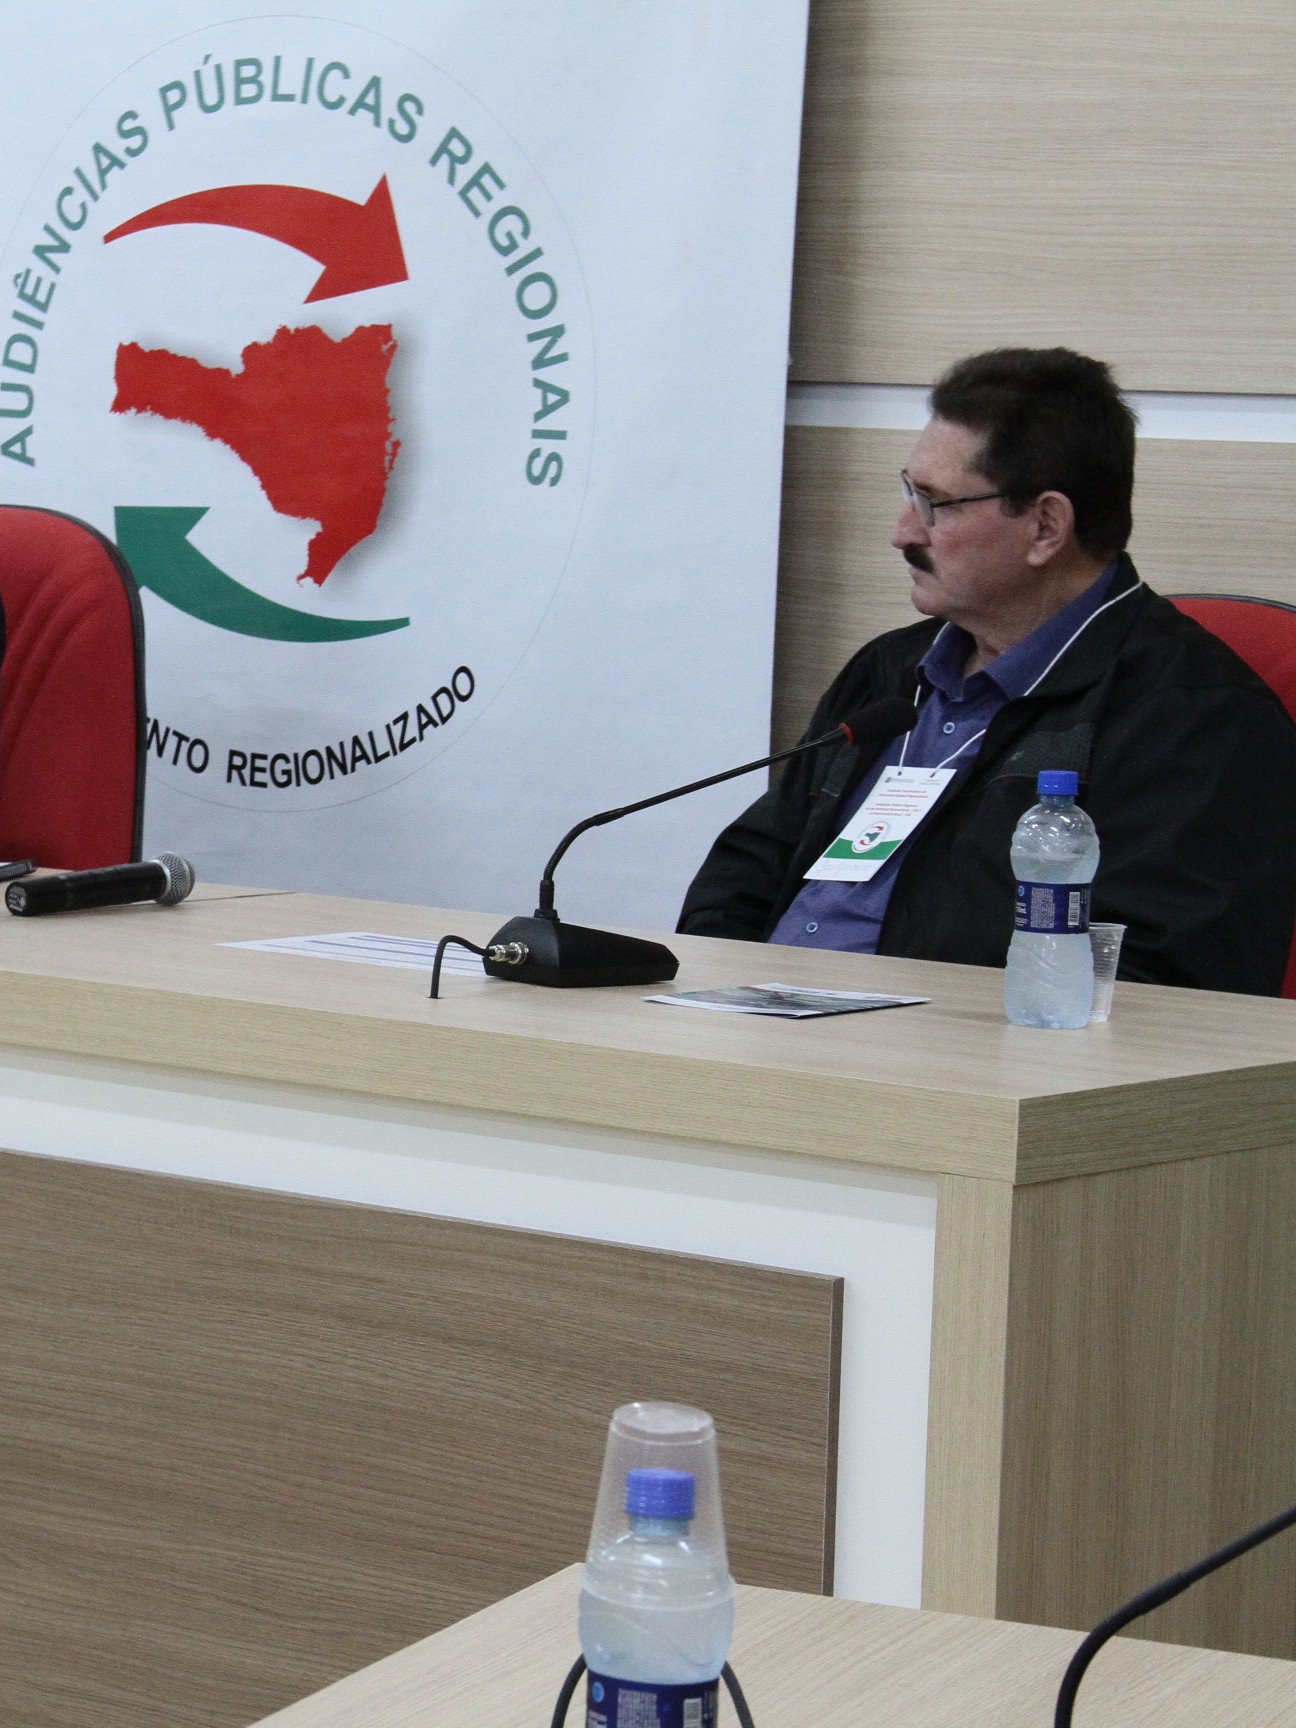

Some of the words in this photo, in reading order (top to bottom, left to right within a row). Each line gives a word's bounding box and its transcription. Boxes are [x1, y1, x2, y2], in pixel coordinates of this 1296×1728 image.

[158, 54, 425, 144] PÚBLICAS
[428, 126, 571, 487] REGIONAIS
[146, 716, 210, 774] NTO
[225, 665, 476, 789] REGIONALIZADO
